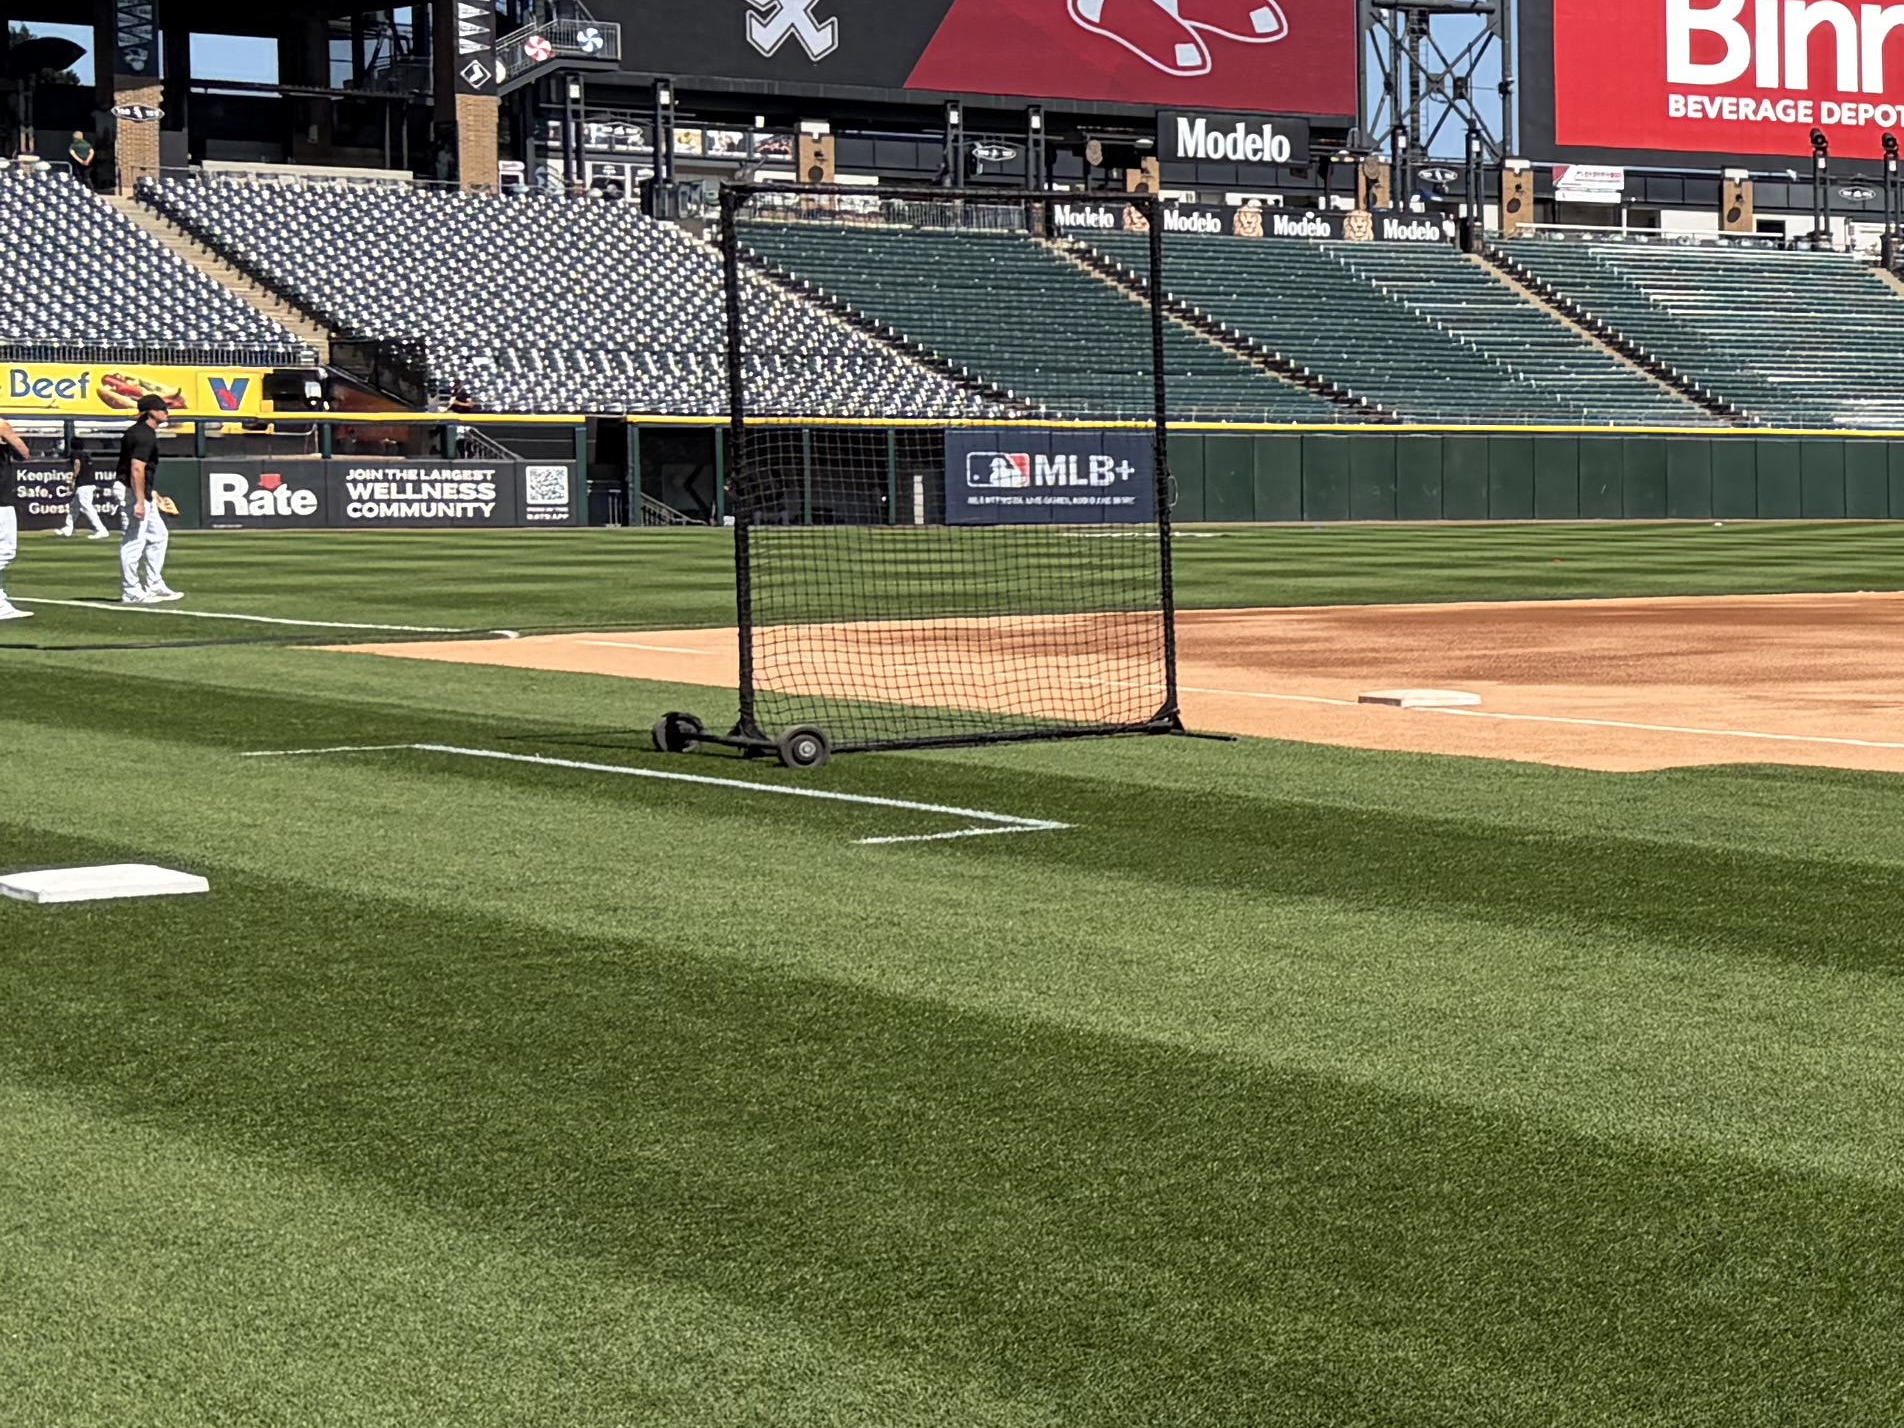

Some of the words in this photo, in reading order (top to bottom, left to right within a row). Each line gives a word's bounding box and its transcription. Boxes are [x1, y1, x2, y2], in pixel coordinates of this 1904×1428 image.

[1668, 94, 1813, 124] BEVERAGE
[1176, 117, 1290, 163] Modelo
[1054, 204, 1114, 228] Modelo
[1163, 209, 1221, 233] Modelo
[1273, 214, 1331, 237] Modelo
[1384, 218, 1440, 241] Modelo
[10, 369, 91, 399] Beef
[346, 470, 384, 481] JOIN
[385, 470, 419, 480] THE
[421, 471, 495, 481] LARGEST
[1035, 454, 1135, 487] MLB+
[17, 486, 53, 499] Safe,
[209, 473, 318, 516] Rate
[346, 483, 496, 500] WELLNESS
[347, 502, 495, 519] COMMUNITY
